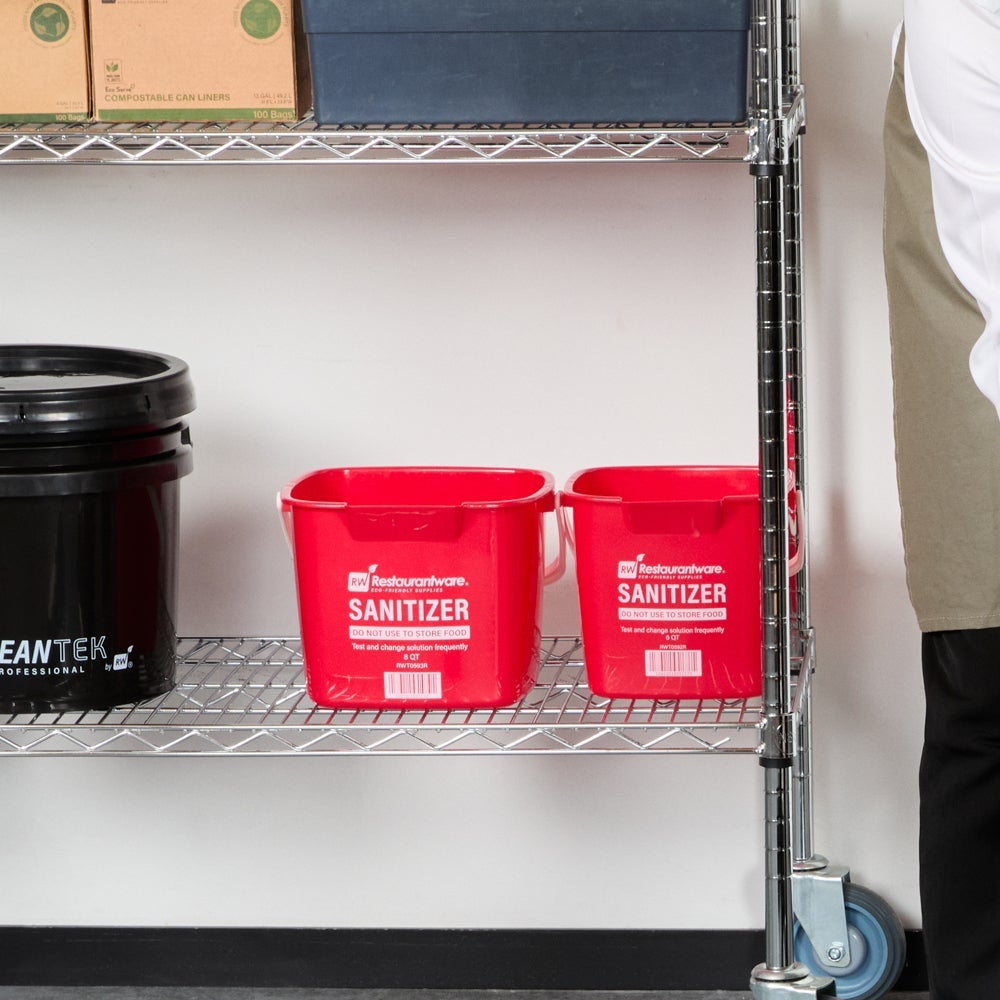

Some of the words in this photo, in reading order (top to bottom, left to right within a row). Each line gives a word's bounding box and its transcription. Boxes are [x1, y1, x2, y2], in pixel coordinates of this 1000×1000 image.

[104, 94, 174, 102] COMPOSTABLE
[175, 94, 195, 102] CAN
[197, 93, 231, 102] LINERS
[253, 110, 268, 119] 100
[270, 110, 293, 120] Bags
[617, 583, 727, 604] SANITIZER
[348, 598, 469, 622] SANITIZER
[650, 610, 664, 618] USE
[366, 629, 382, 637] NOT
[385, 629, 400, 637] USE
[646, 627, 668, 635] change
[694, 626, 724, 635] frequently
[366, 643, 379, 651] and
[380, 643, 405, 652] change
[434, 643, 468, 652] frequently
[409, 653, 420, 661] QT
[104, 663, 112, 672] by
